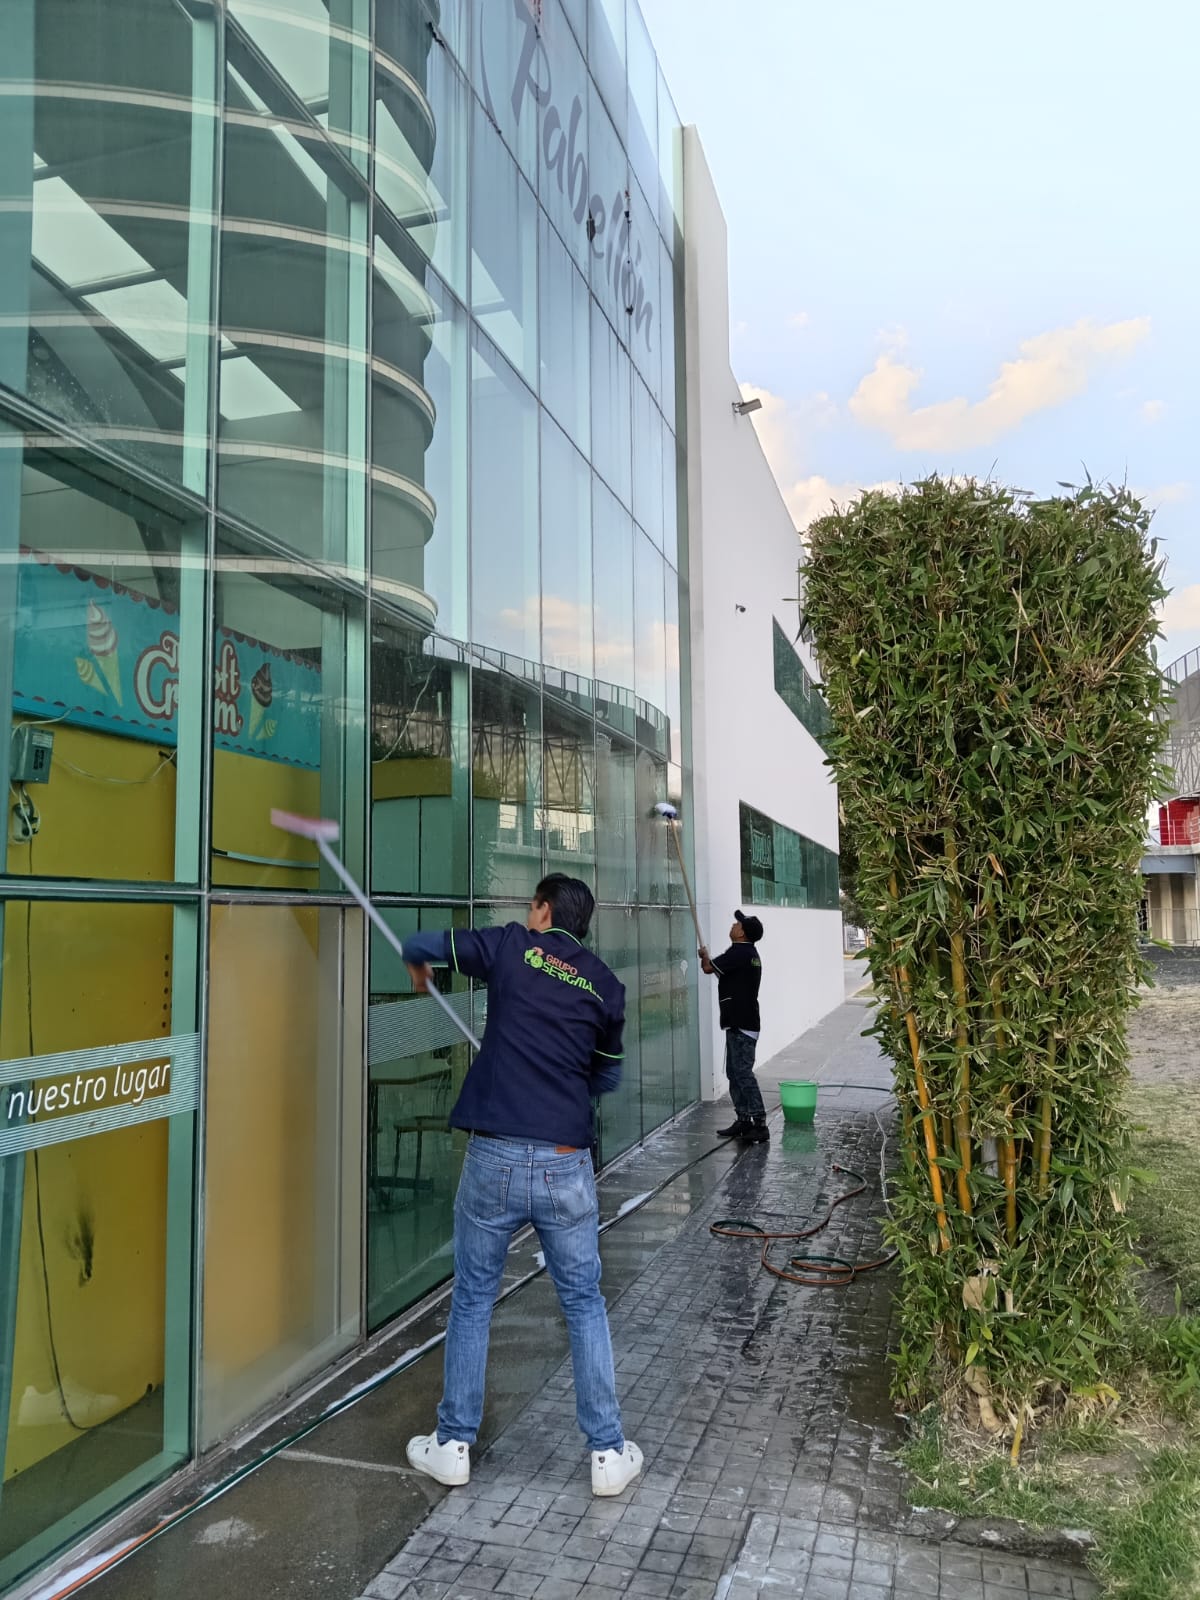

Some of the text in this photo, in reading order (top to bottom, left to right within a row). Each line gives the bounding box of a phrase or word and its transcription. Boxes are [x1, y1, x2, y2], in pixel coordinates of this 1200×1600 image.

[545, 953, 578, 976] GRUPO
[8, 1064, 171, 1120] nuestro lugar
